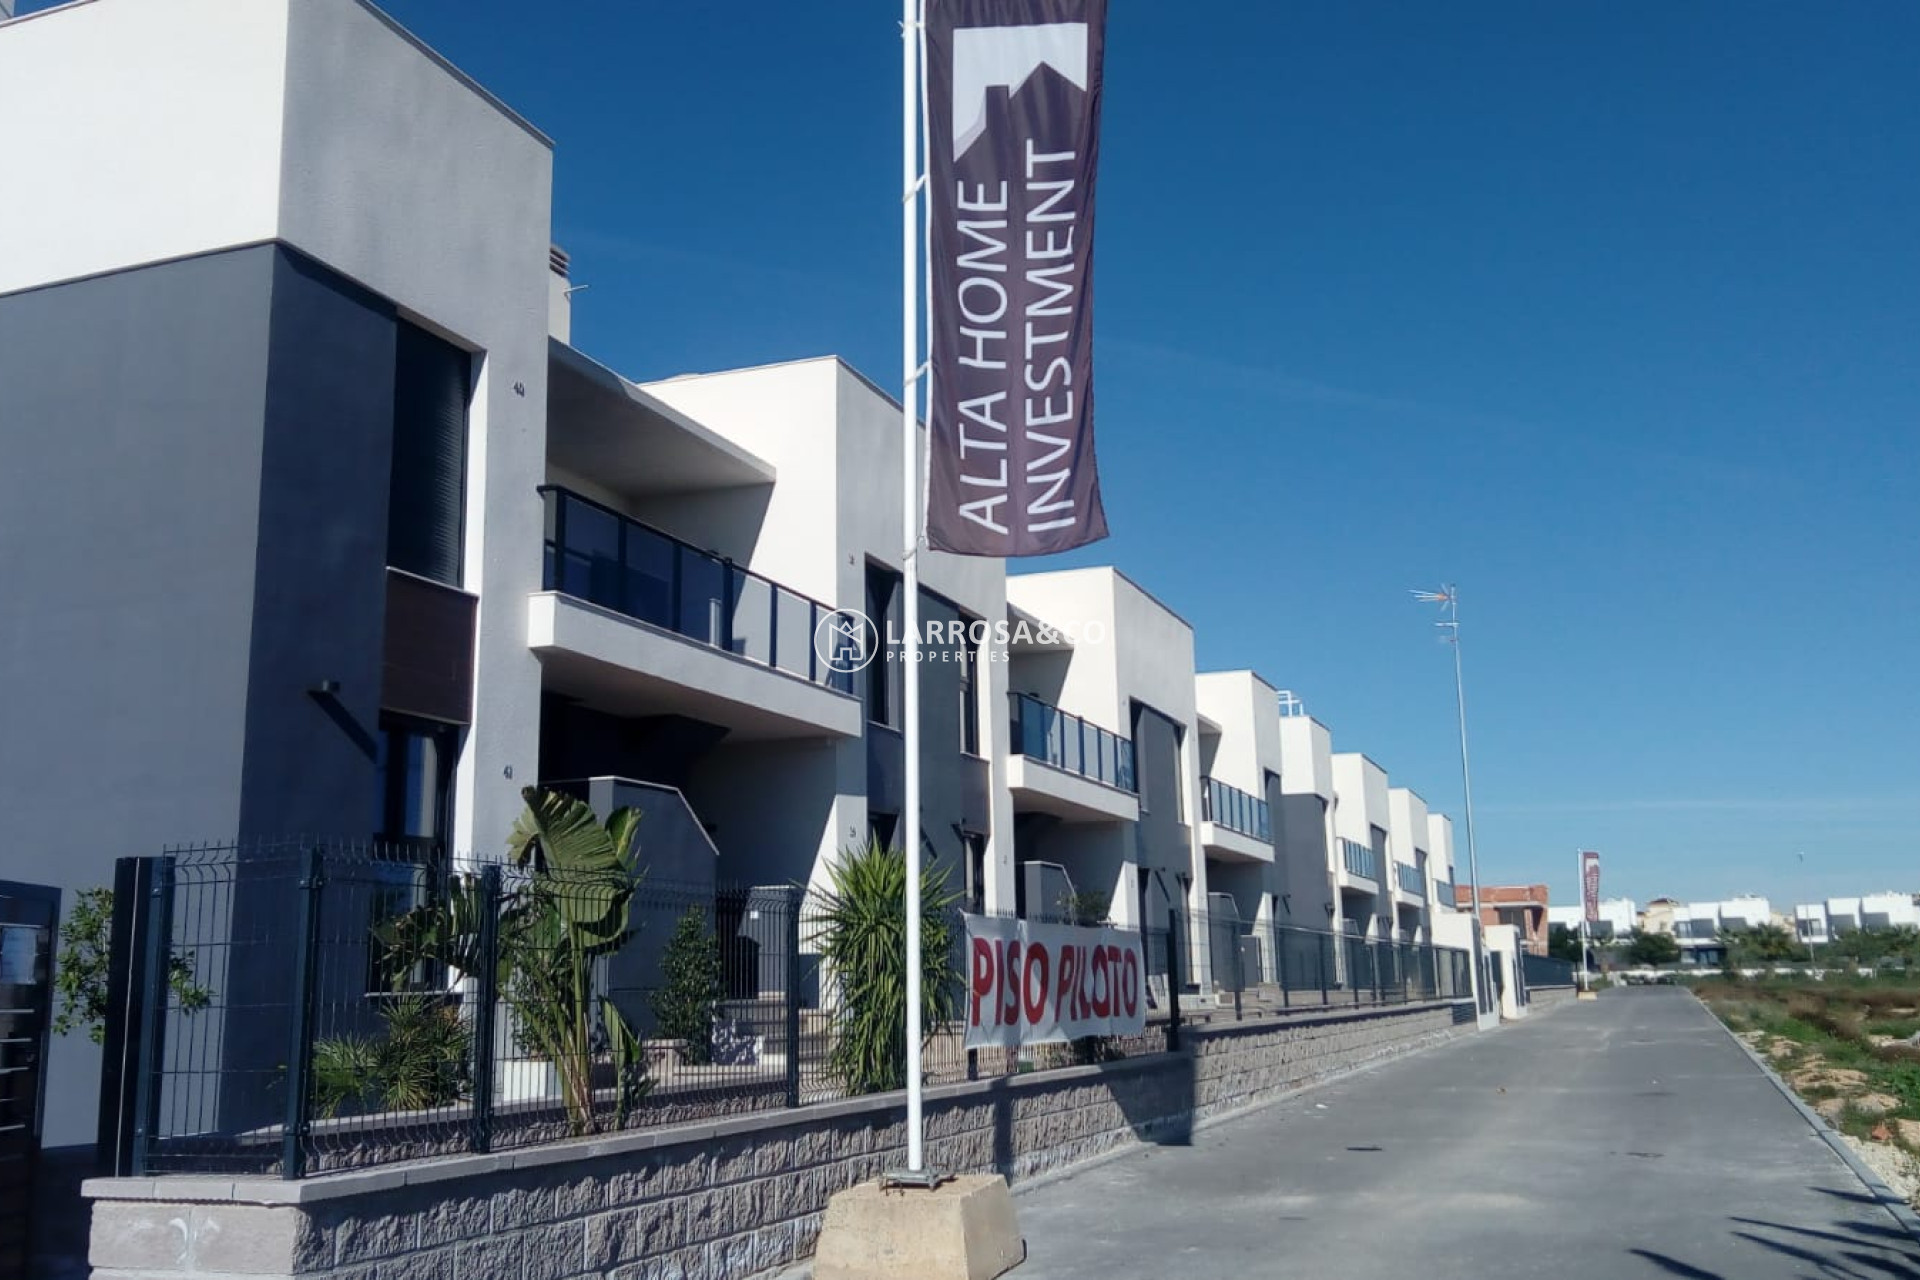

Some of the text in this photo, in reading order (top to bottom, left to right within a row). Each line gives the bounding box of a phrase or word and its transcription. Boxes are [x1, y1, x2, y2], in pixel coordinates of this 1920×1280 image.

[957, 180, 1008, 535] ALTA HOME
[1025, 139, 1077, 533] INVESTMENT
[971, 937, 1138, 1027] PISO PILOTO
